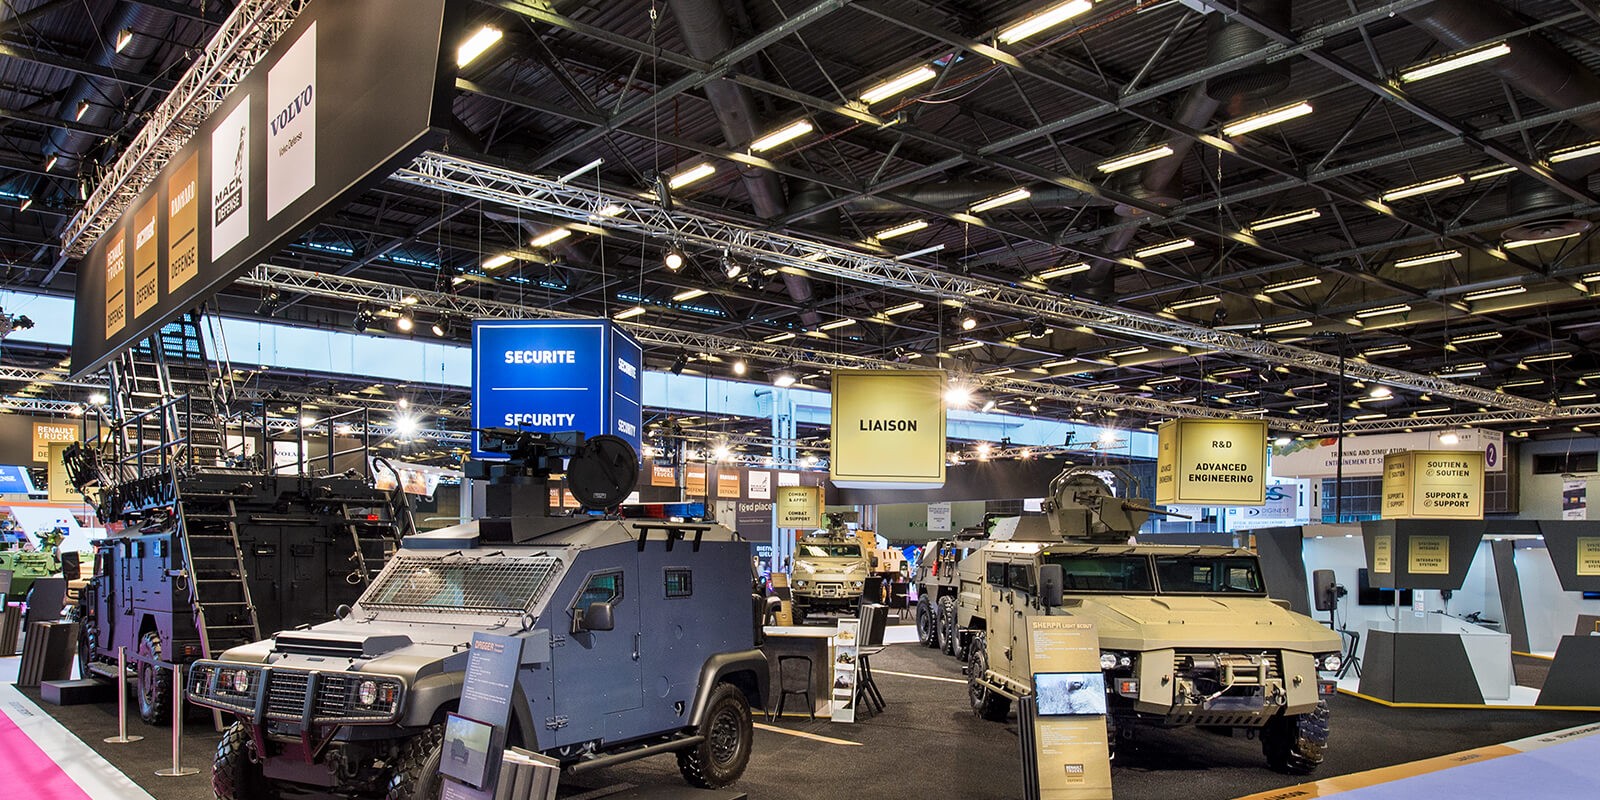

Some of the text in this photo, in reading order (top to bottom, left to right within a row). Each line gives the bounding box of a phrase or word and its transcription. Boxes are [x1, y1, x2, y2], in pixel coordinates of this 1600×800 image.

[270, 84, 313, 137] VOLVO
[215, 175, 242, 206] MACK
[217, 192, 240, 222] DEFENSE
[171, 246, 195, 279] DEFENSE
[136, 278, 155, 306] DEFENSE
[108, 304, 124, 328] DEFENSE
[504, 350, 576, 364] SECURITE
[504, 413, 576, 426] SECURITY
[859, 419, 917, 431] LIAISON
[37, 426, 75, 434] RENAULT
[37, 433, 75, 441] TRUCKS
[1211, 440, 1232, 448] R&D
[273, 447, 304, 456] VOLV
[1331, 449, 1357, 457] TRNING
[1371, 447, 1407, 455] SIMUATION
[1195, 463, 1247, 471] ADVANCED
[1427, 461, 1468, 469] SOUTIEN &
[1436, 469, 1470, 477] SOUTIEN
[1188, 474, 1254, 483] ENGINEERING
[1433, 500, 1470, 508] SUPPORT
[1032, 621, 1061, 629] SHERPA
